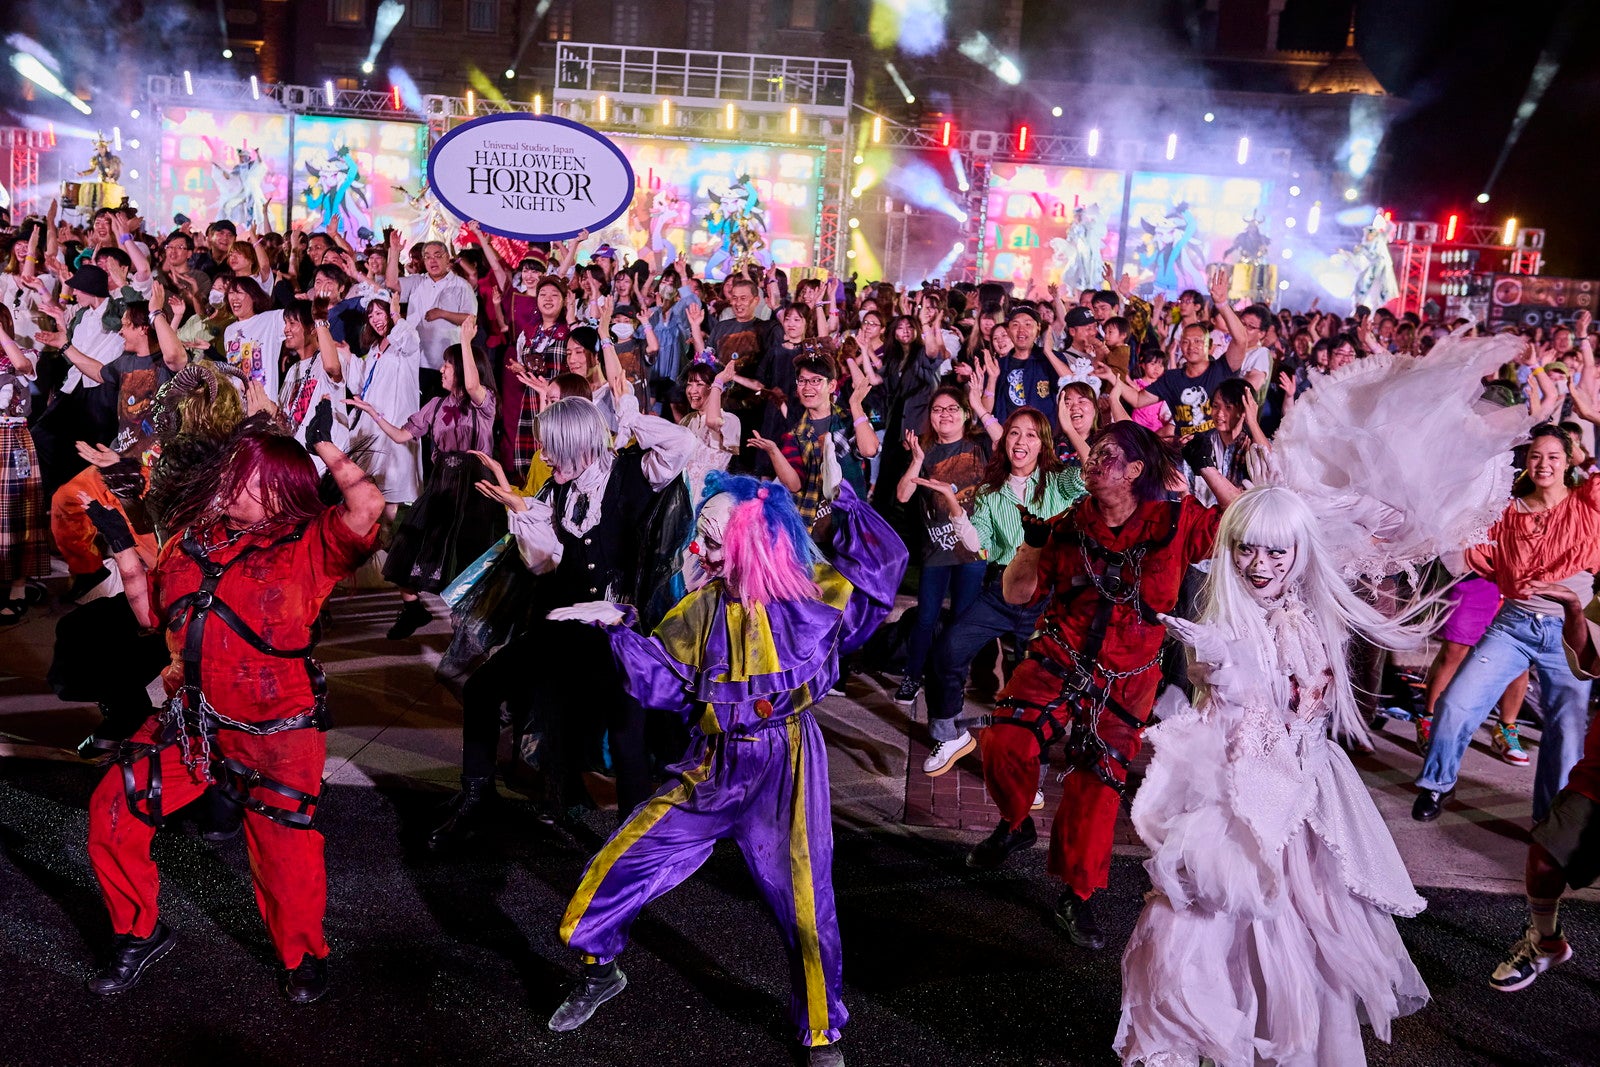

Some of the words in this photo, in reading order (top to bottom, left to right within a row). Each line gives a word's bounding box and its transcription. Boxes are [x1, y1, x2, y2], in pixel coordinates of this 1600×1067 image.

[483, 140, 519, 151] Universal
[521, 142, 550, 153] Studios
[552, 144, 575, 156] Japan
[475, 150, 587, 172] HALLOWEEN
[466, 166, 597, 207] HORROR
[501, 194, 566, 213] NIGHTS
[928, 522, 955, 543] Ham
